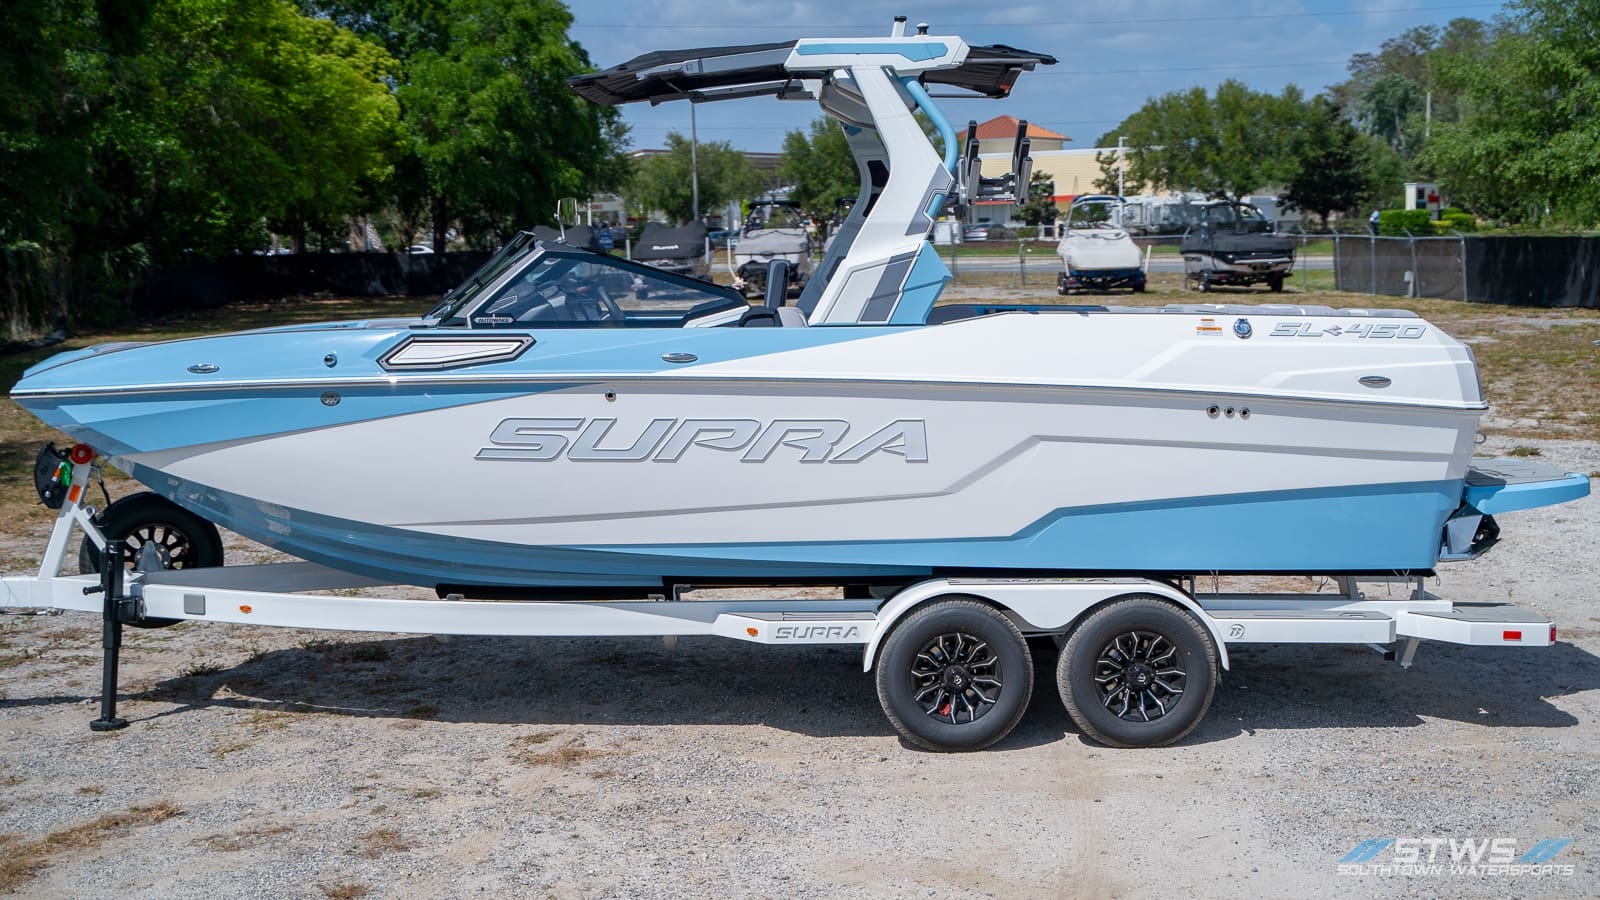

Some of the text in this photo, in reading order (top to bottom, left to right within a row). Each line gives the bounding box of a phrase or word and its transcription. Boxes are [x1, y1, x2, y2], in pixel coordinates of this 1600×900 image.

[1344, 324, 1426, 339] 450
[474, 417, 928, 463] SUPRA
[775, 626, 861, 639] SUPRA
